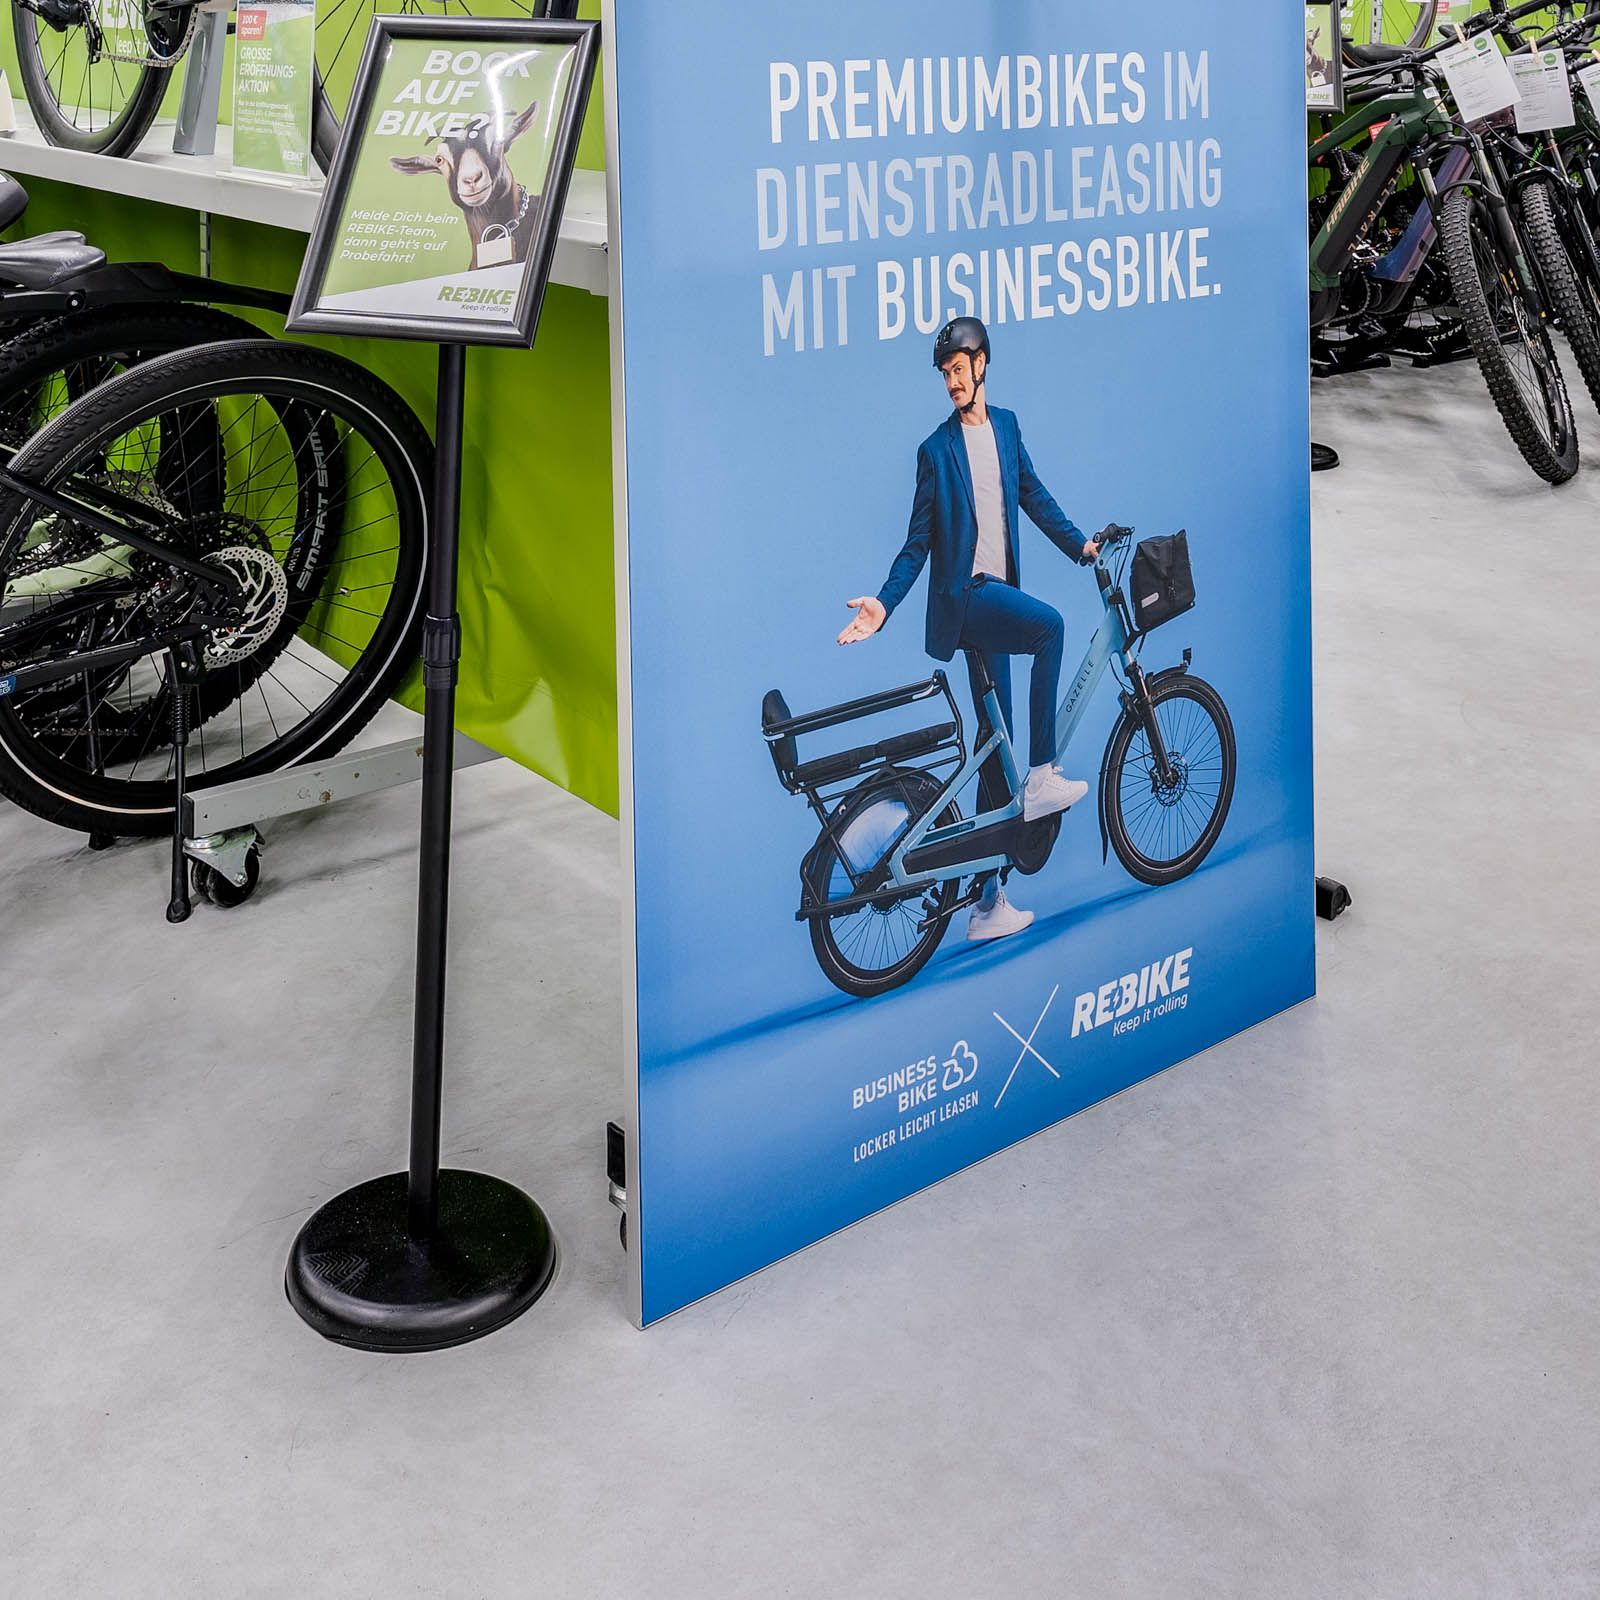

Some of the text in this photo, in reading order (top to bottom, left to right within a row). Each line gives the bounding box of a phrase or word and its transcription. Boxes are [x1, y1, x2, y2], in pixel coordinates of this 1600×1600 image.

[240, 47, 272, 61] GROSSE
[240, 62, 297, 79] ERÖFFNUNGS-
[239, 80, 270, 94] AKTION
[392, 79, 480, 105] AUF
[769, 50, 1210, 144] PREMIUMBIKES IM
[374, 110, 490, 139] BIKE?
[755, 137, 1223, 252] DIENSTRADLEASING
[1326, 155, 1370, 232] HAIBIKE
[347, 223, 437, 239] REBIKE-Team,
[351, 209, 459, 224] Melde Dich beim
[340, 249, 415, 265] Probefahrt!
[343, 236, 378, 248] dann
[423, 240, 447, 252] auf
[438, 286, 516, 305] REBIKE
[761, 227, 1222, 356] MIT BUSINESSBIKE.
[460, 303, 479, 313] Keep
[487, 304, 509, 314] rolling
[296, 431, 329, 591] SMART SAM
[1065, 660, 1095, 713] GAZELLE
[1070, 947, 1193, 1039] REBIKE
[1112, 992, 1188, 1038] Keep it rolling
[852, 1055, 937, 1110] BUSINESS
[898, 1078, 937, 1114] BIKE
[853, 1090, 979, 1164] LOCKER LEICHT LEASEN
